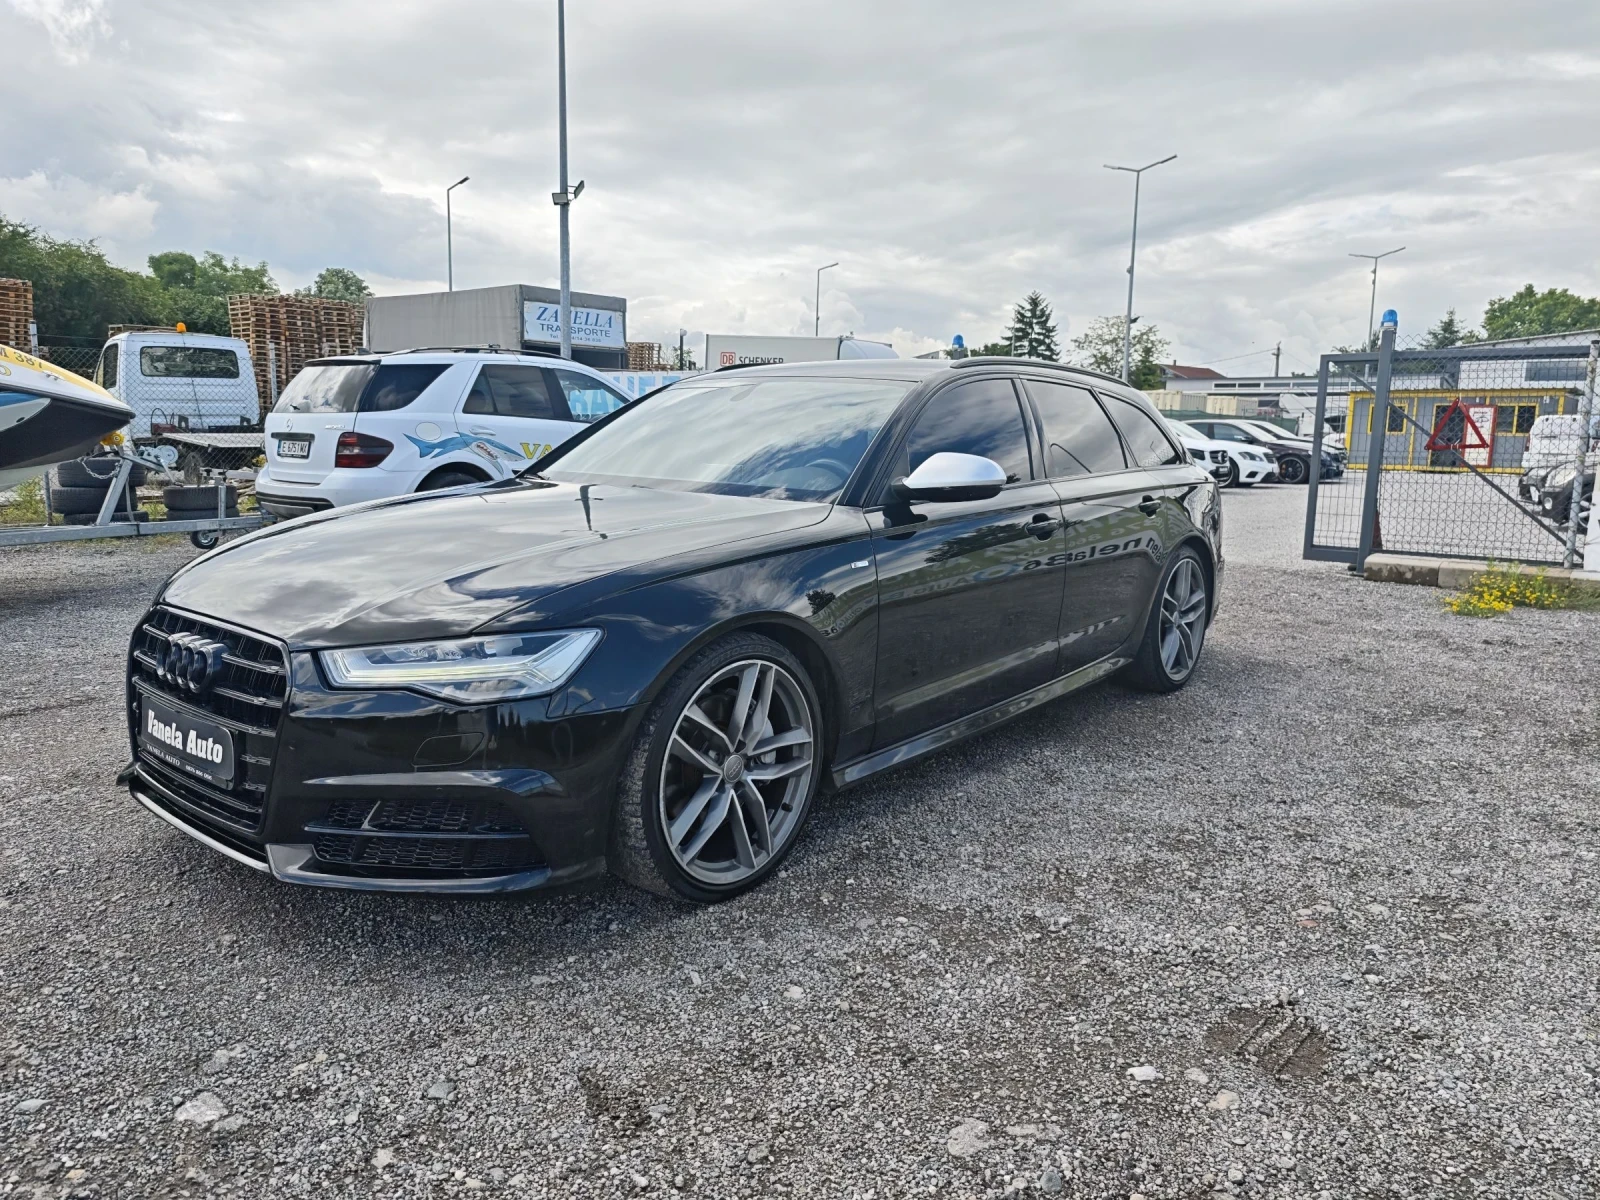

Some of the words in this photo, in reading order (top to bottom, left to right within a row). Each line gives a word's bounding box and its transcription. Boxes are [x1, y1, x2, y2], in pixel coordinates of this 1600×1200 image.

[536, 306, 612, 329] ZAELLA
[540, 323, 611, 338] TRASPORTE
[722, 354, 734, 365] DB
[147, 709, 183, 751] Vanela
[186, 729, 223, 764] Auto
